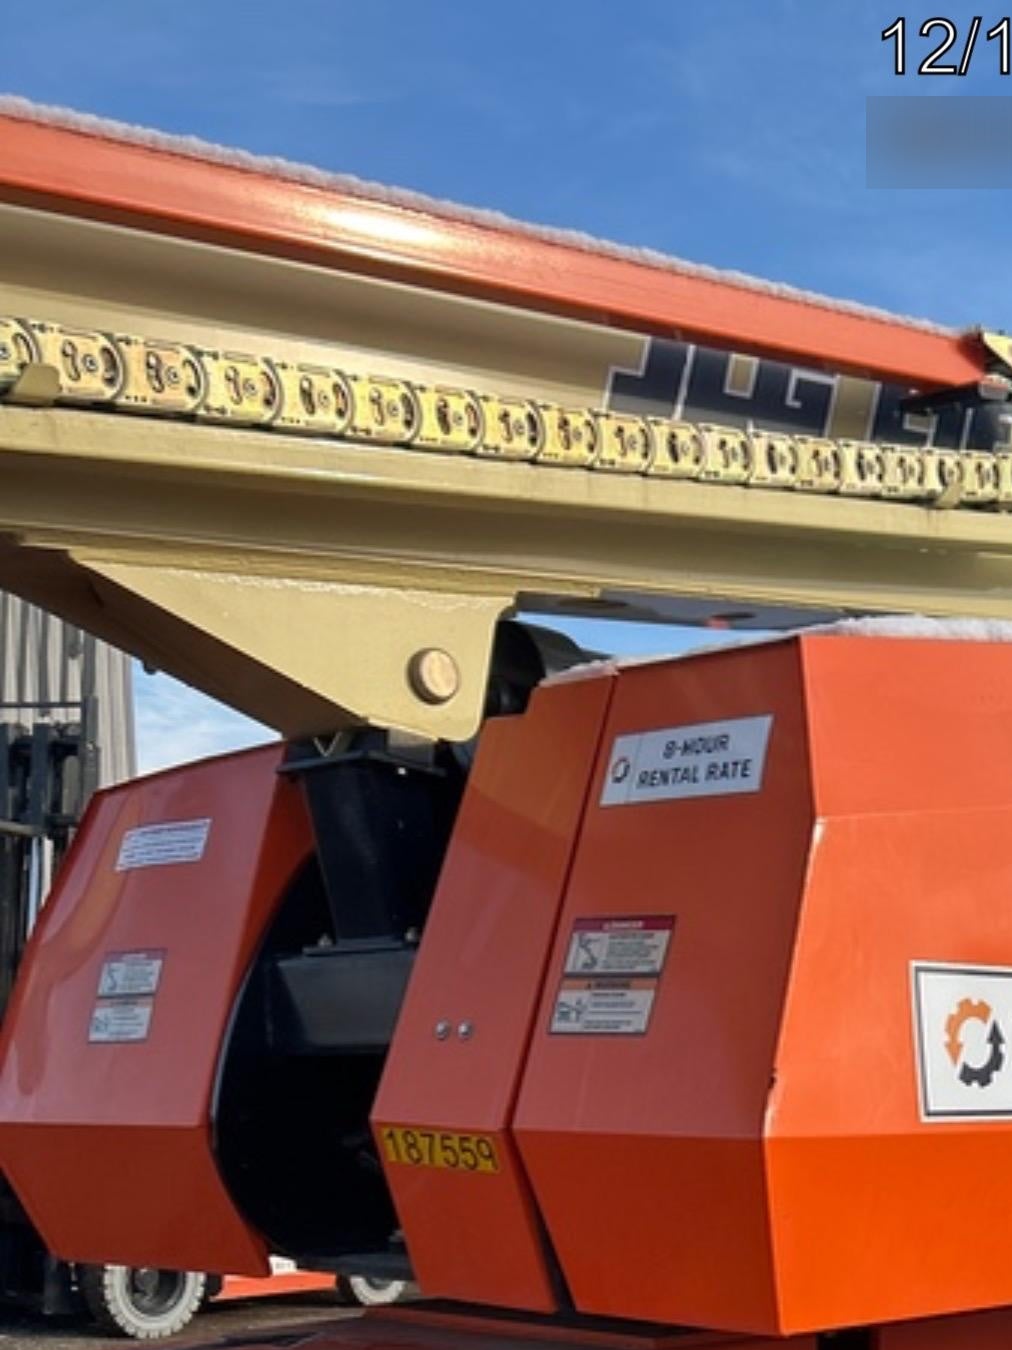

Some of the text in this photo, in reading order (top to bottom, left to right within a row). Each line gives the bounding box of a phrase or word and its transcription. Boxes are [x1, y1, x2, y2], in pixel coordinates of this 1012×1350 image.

[636, 758, 752, 790] RENTAL RATE
[384, 1130, 498, 1171] 187559
